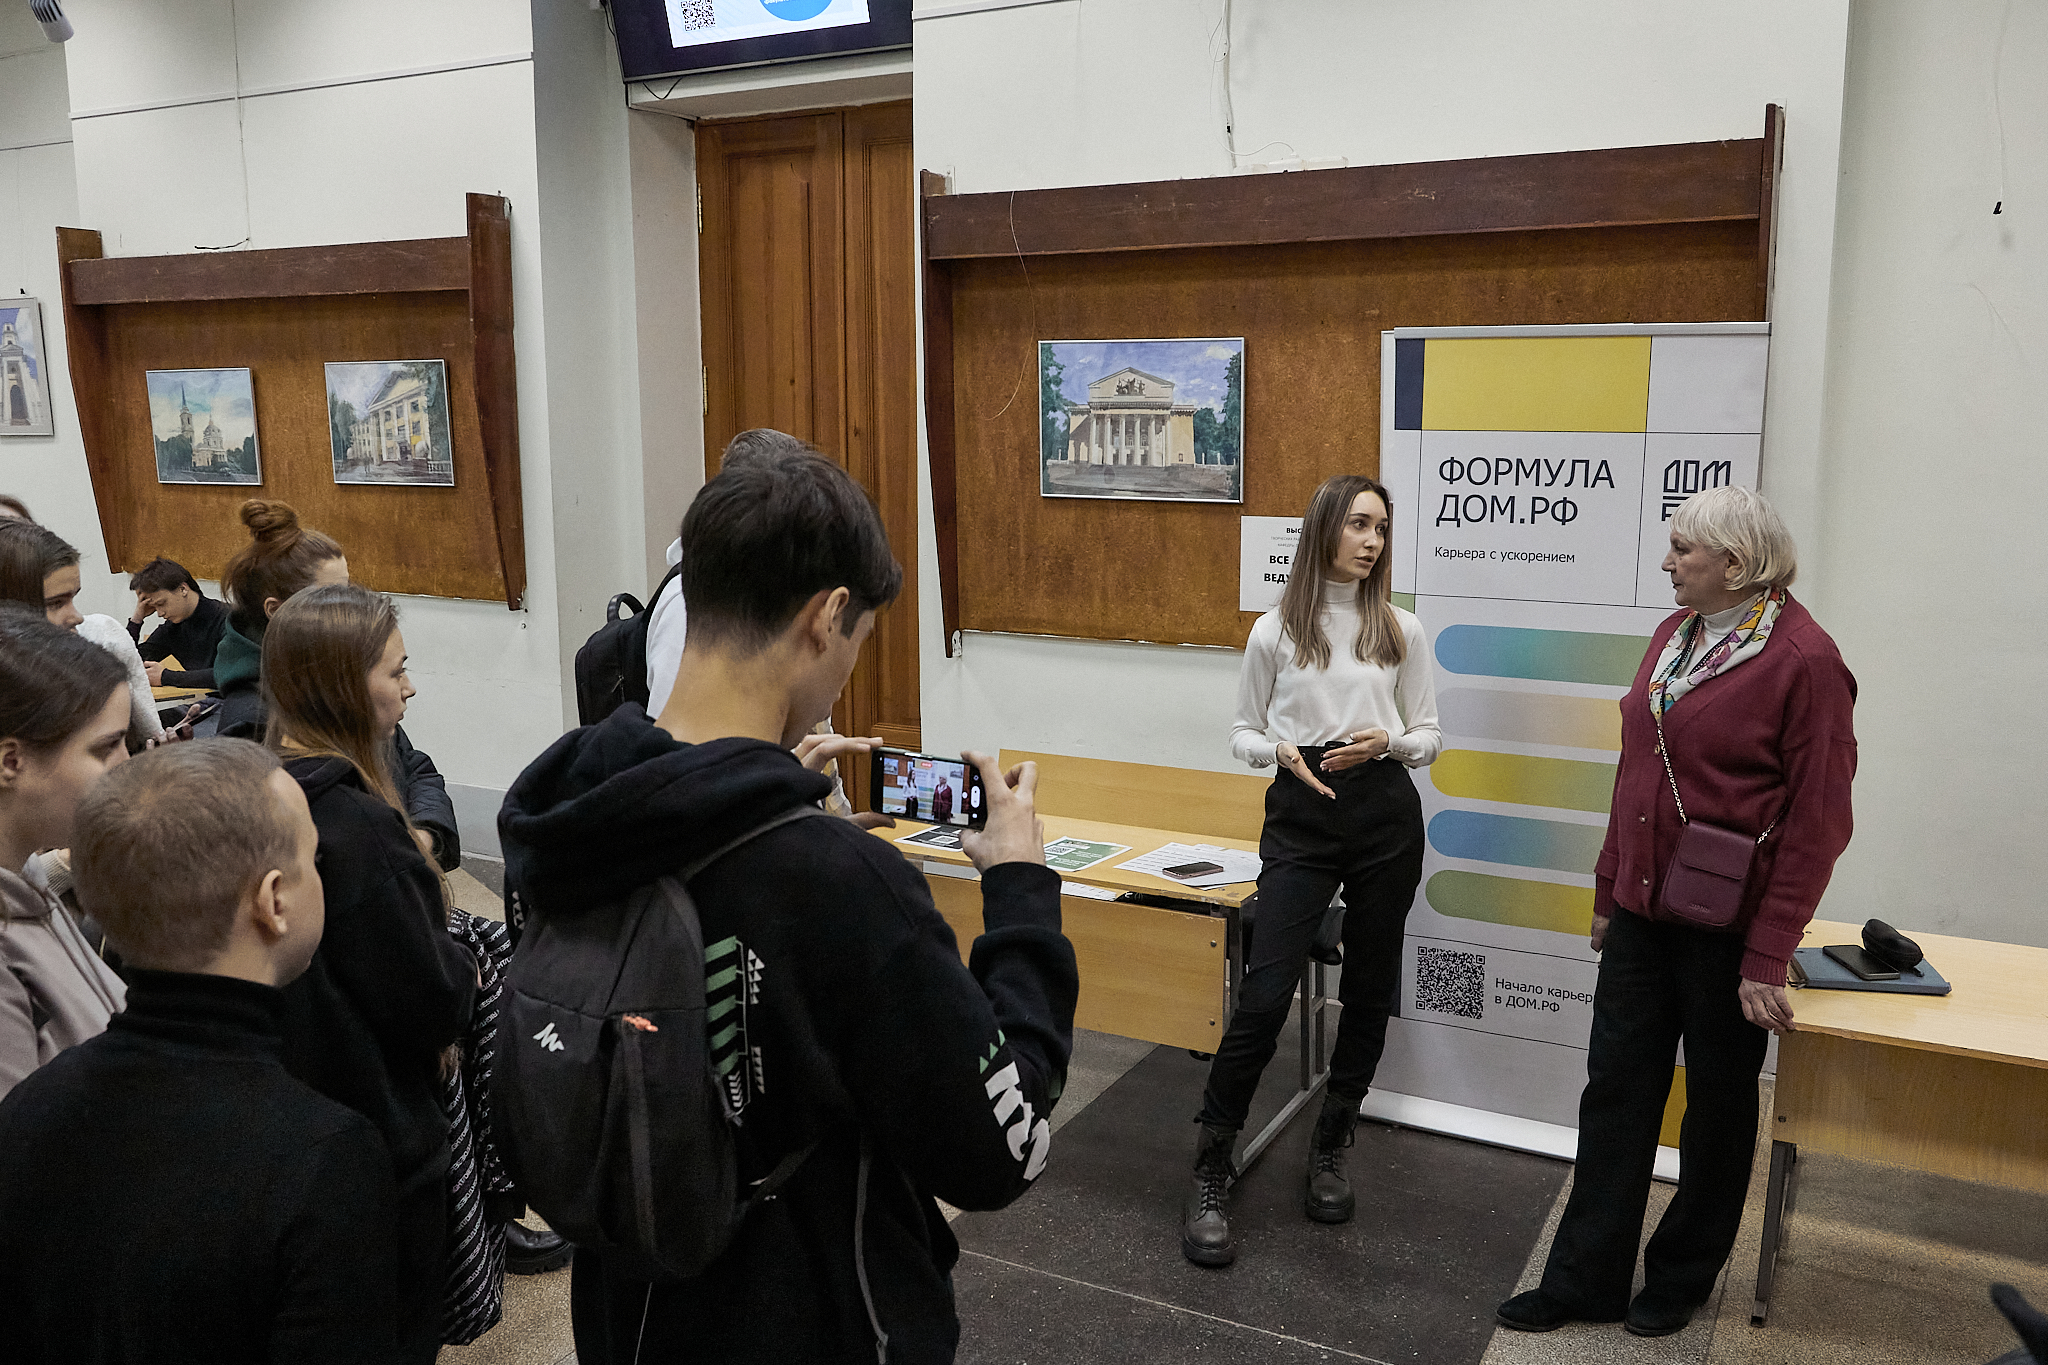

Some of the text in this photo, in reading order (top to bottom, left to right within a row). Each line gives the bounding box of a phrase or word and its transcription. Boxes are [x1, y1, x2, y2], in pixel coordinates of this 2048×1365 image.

[1438, 456, 1615, 489] ФОРМУЛА
[1435, 493, 1579, 528] ДОМ.РФ
[1269, 554, 1290, 565] ВСЕ
[1434, 546, 1575, 564] Карьера с ускорением
[1495, 977, 1593, 1004] Начало карьер
[1494, 994, 1561, 1013] в ДОМ.РФ
